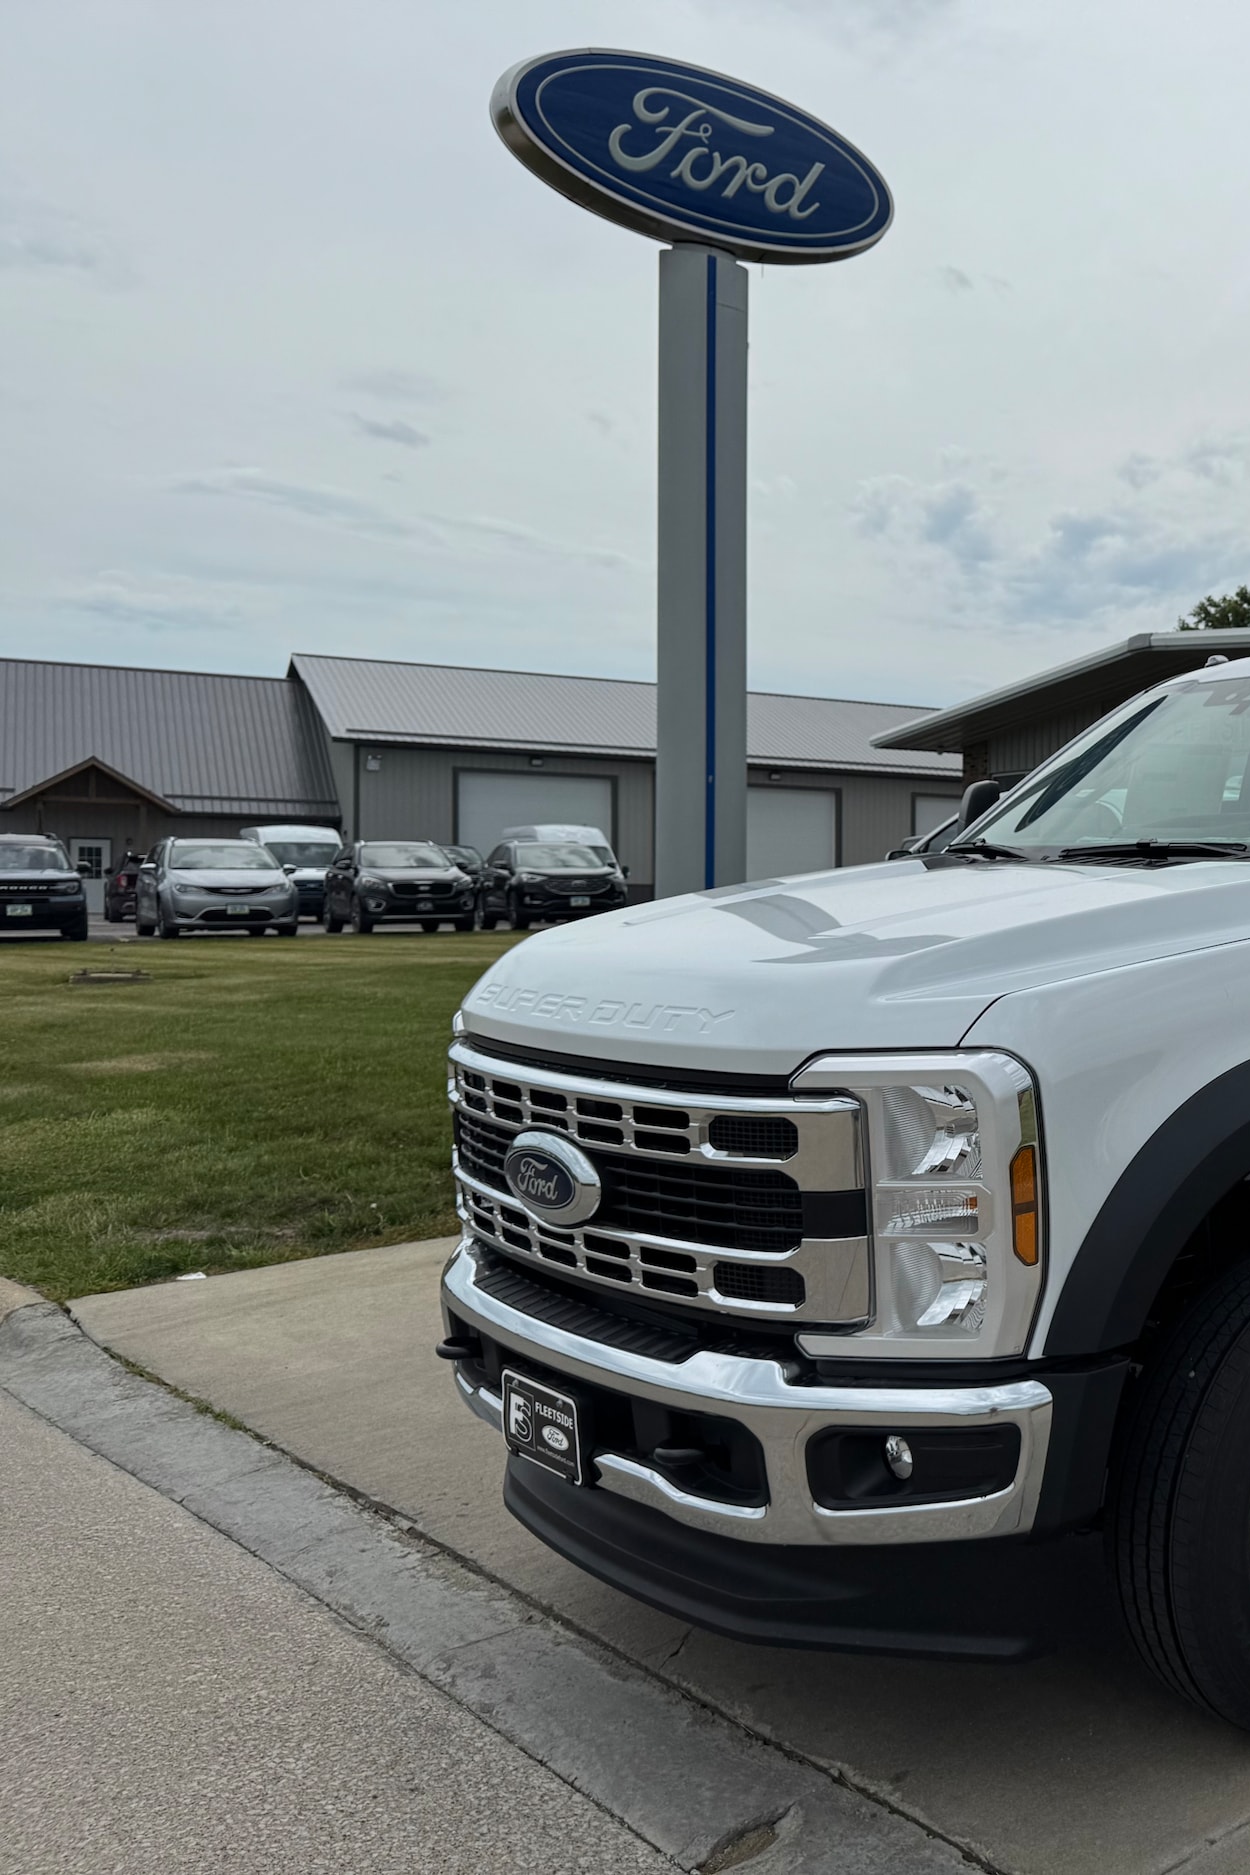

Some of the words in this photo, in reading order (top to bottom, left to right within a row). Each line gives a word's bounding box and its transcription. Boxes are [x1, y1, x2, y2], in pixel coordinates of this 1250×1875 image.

[608, 86, 826, 219] Ford
[476, 982, 588, 1022] SUPER
[588, 998, 736, 1034] DUTY
[517, 1157, 558, 1201] Ford
[534, 1401, 574, 1430] FLEETSIDE
[546, 1428, 565, 1447] Ford
